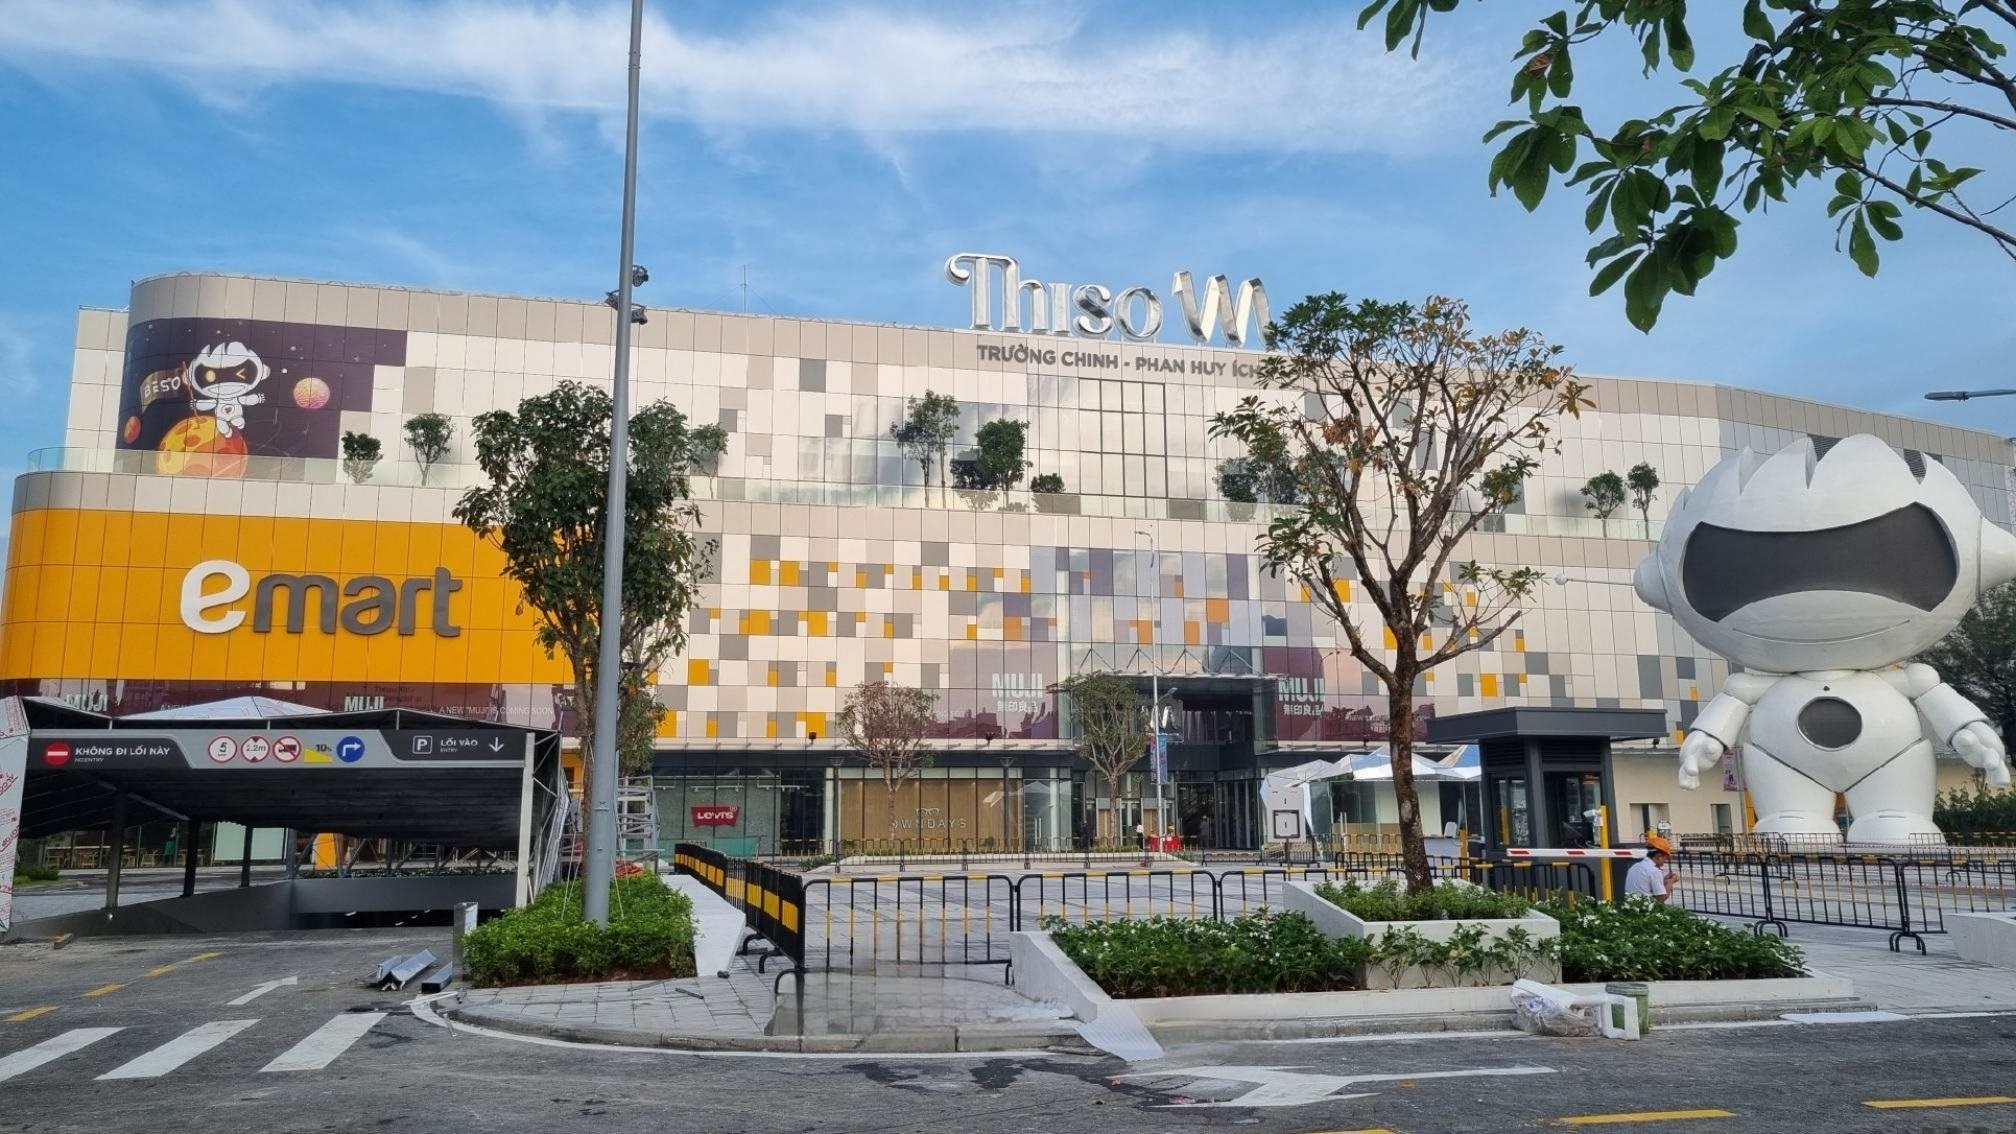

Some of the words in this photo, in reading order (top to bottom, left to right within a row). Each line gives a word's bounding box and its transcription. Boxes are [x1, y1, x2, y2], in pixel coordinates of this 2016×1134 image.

[976, 344, 1056, 365] TRƯỜNG
[1061, 351, 1119, 369] CHINH
[1136, 356, 1186, 373] PHAN
[1191, 360, 1226, 376] HUY
[143, 374, 182, 399] BESO
[180, 559, 464, 638] emart
[992, 672, 1044, 698] MUJI
[1278, 676, 1326, 703] MUJI
[344, 695, 384, 712] MUJI
[447, 706, 464, 714] NEW
[75, 745, 113, 756] KHÔNG
[115, 747, 127, 756] ĐI
[129, 744, 147, 756] LỐI
[149, 745, 170, 756] NÀY
[219, 742, 228, 753] 5
[416, 738, 428, 751] P
[440, 736, 457, 747] LỐI
[458, 738, 479, 747] VÀO
